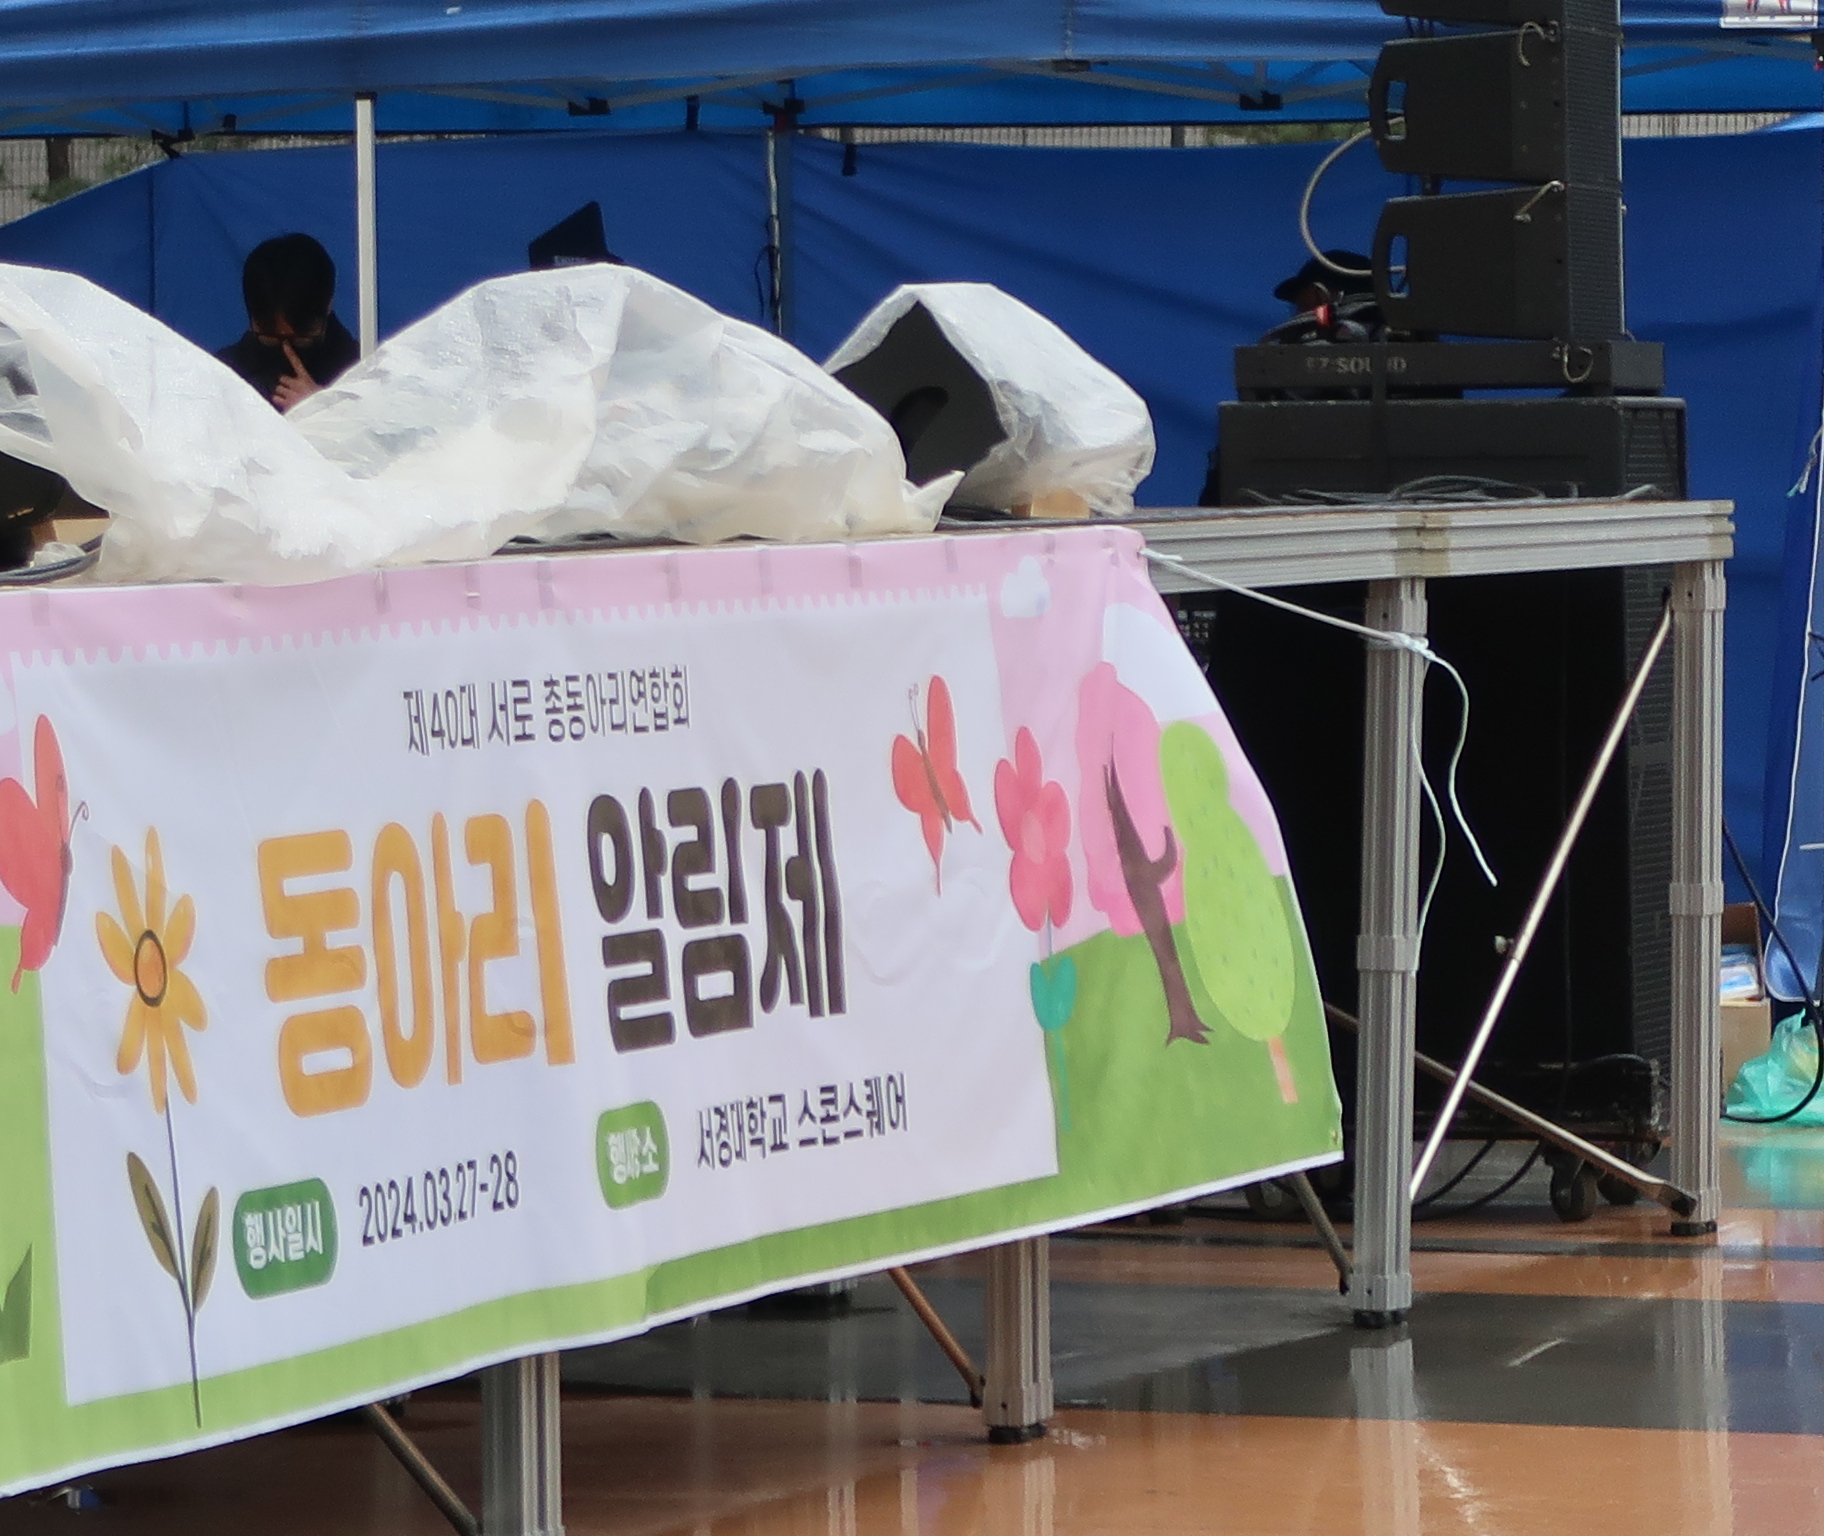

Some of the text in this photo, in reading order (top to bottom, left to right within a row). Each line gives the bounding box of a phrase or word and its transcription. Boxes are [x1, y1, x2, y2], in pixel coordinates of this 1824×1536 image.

[403, 664, 691, 757] 제40대 서로 총동아리연합회
[257, 767, 847, 1118] 동아리 알림제
[697, 1093, 790, 1170] 서경대학교
[798, 1071, 908, 1147] 스콘스퀘어
[243, 1150, 520, 1270] 행사일시 2024.03.27-28
